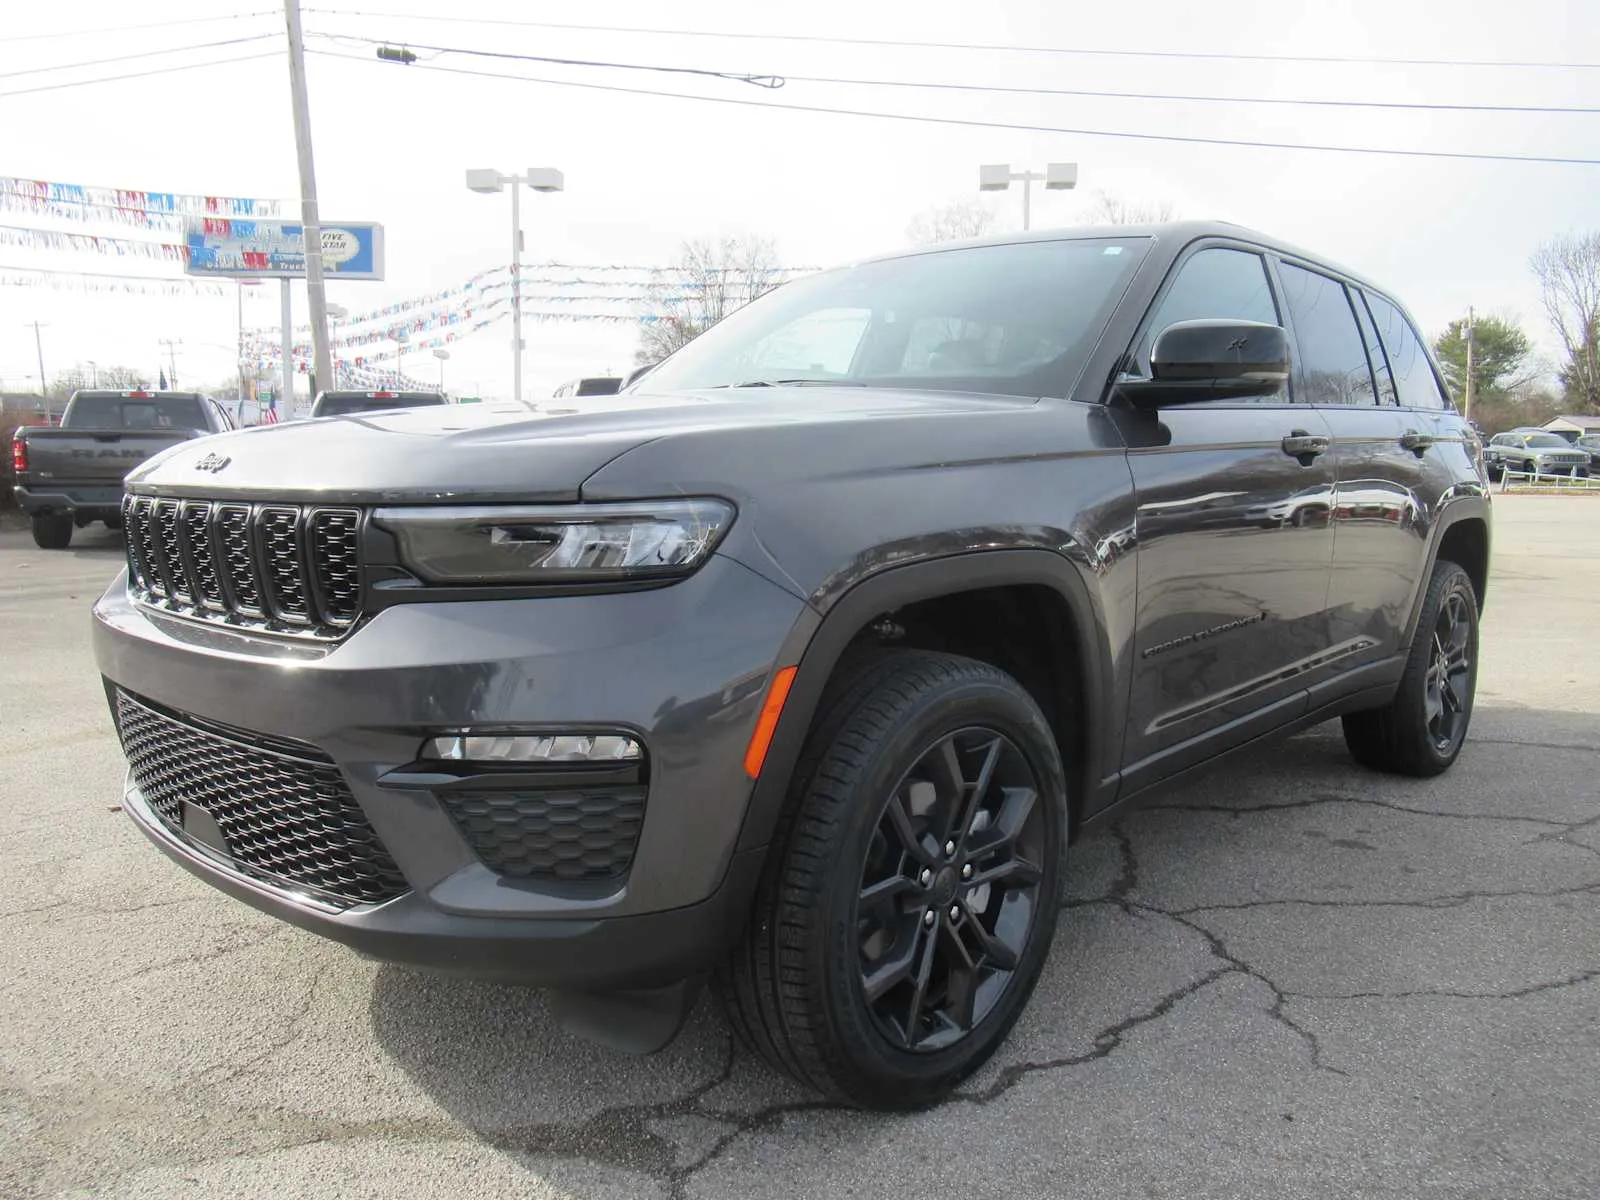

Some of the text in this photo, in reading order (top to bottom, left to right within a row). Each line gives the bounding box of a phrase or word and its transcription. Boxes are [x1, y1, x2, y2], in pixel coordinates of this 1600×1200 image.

[321, 233, 345, 241] FIVE
[321, 241, 346, 249] STAR
[72, 449, 145, 458] RAM
